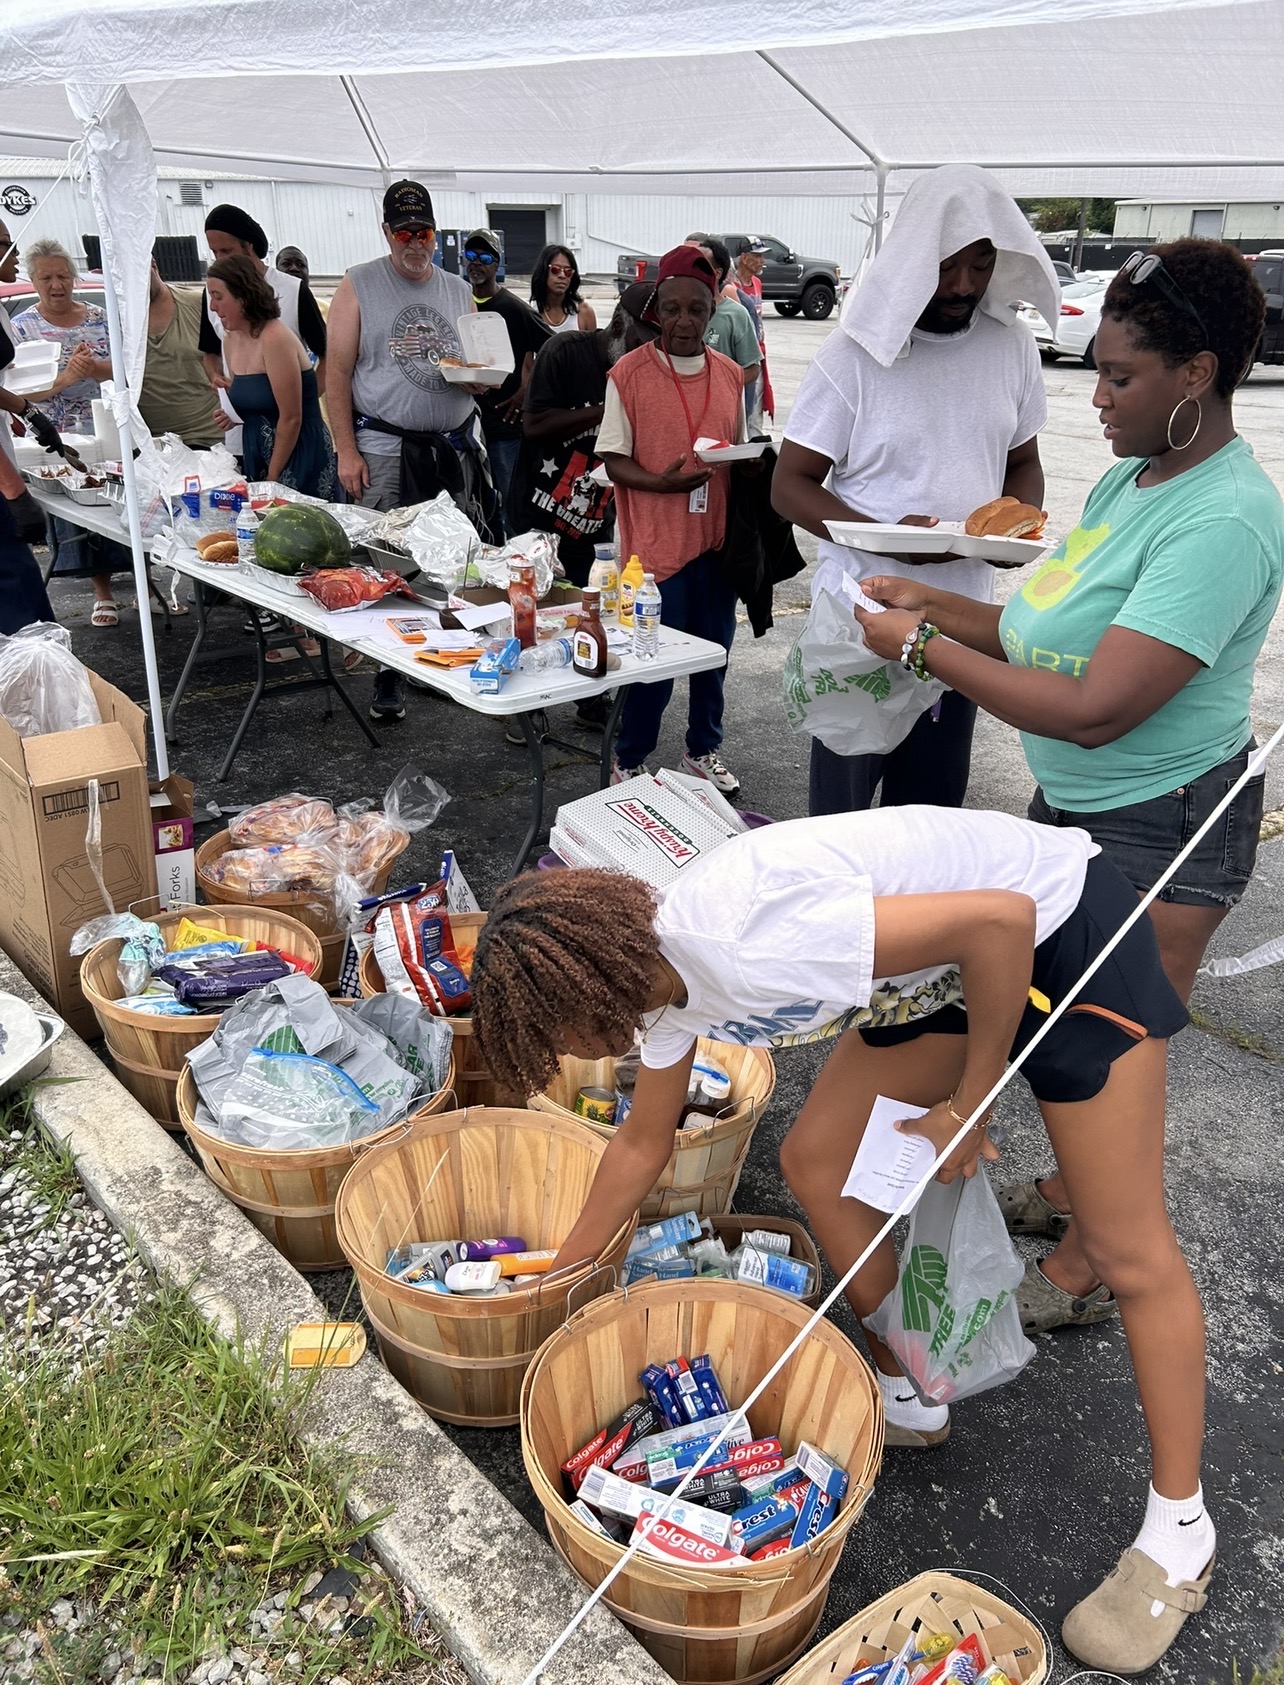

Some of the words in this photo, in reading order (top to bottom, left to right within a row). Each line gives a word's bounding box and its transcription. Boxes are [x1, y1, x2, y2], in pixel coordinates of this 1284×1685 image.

[0, 195, 37, 205] DYKES
[396, 308, 423, 338] VINTAGE
[403, 363, 426, 386] MADE
[532, 487, 557, 512] THE
[169, 866, 181, 903] Forks
[632, 1265, 654, 1274] Hand
[566, 1436, 604, 1469] Colgate
[578, 1438, 624, 1483] Clgate
[728, 1442, 775, 1462] Colga
[618, 1464, 648, 1481] Colg
[739, 1460, 780, 1477] Colga
[707, 1490, 730, 1500] ULTRA
[709, 1495, 731, 1504] WHITE
[732, 1504, 776, 1535] Crest
[807, 1490, 832, 1540] Crest
[641, 1515, 718, 1560] Colgate
